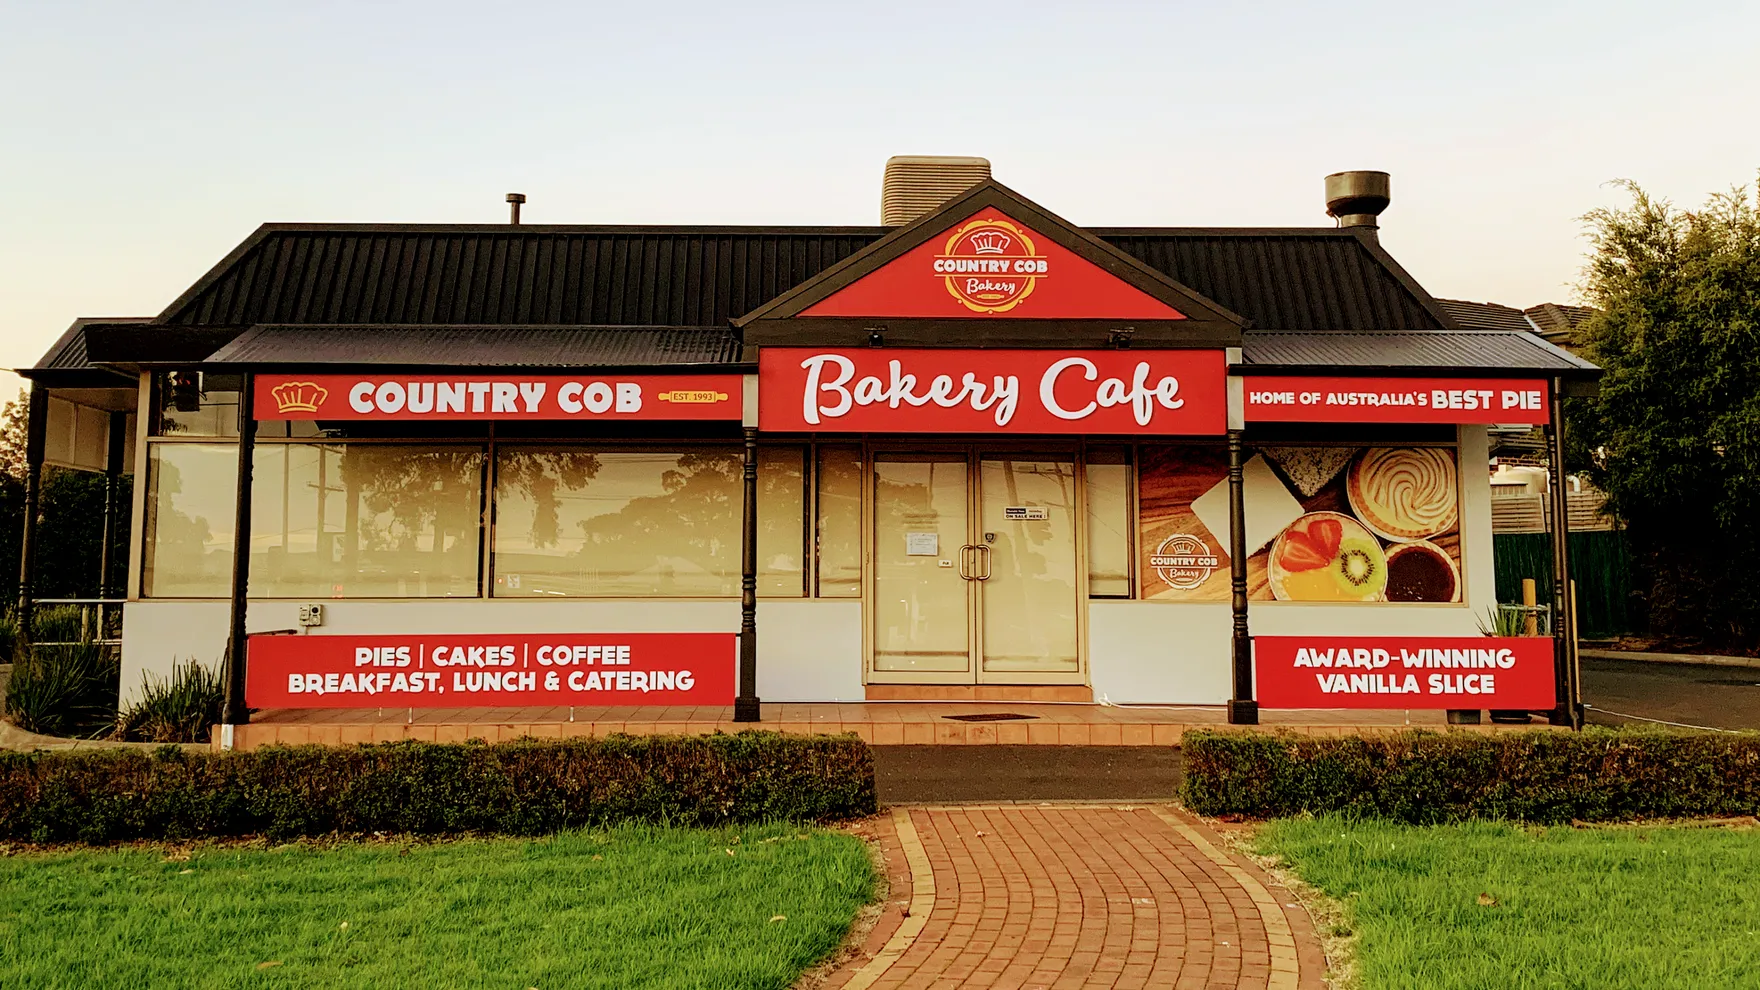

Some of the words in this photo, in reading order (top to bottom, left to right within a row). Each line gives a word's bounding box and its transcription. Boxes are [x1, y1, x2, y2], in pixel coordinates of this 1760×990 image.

[933, 260, 1010, 273] COUNTRY
[1013, 260, 1048, 273] COB
[965, 278, 1016, 295] Bakery
[348, 381, 547, 414] COUNTRY
[557, 381, 643, 414] COB
[673, 392, 692, 401] EST.
[693, 392, 713, 401] 1993
[801, 354, 1019, 427] Bakery
[1039, 357, 1184, 427] Cafe
[1249, 391, 1295, 405] HOME
[1299, 391, 1321, 405] OF
[1325, 391, 1428, 407] AUSTRALIA'S
[1431, 389, 1494, 410] BEST
[1501, 390, 1542, 410] PIE
[1150, 557, 1196, 566] COUNTRY
[1197, 557, 1218, 566] COB
[1169, 568, 1200, 579] Bakery
[355, 646, 411, 667] PIES
[431, 645, 516, 669] CAKES
[536, 645, 631, 666] COFFEE
[1293, 647, 1516, 671] AWARD-WINNING
[288, 671, 445, 696] BREAKFAST,
[453, 671, 536, 692] LUNCH
[543, 670, 560, 691] &
[567, 670, 696, 694] CATERING
[1315, 673, 1421, 694] VANILLA
[1428, 673, 1495, 695] SLICE
